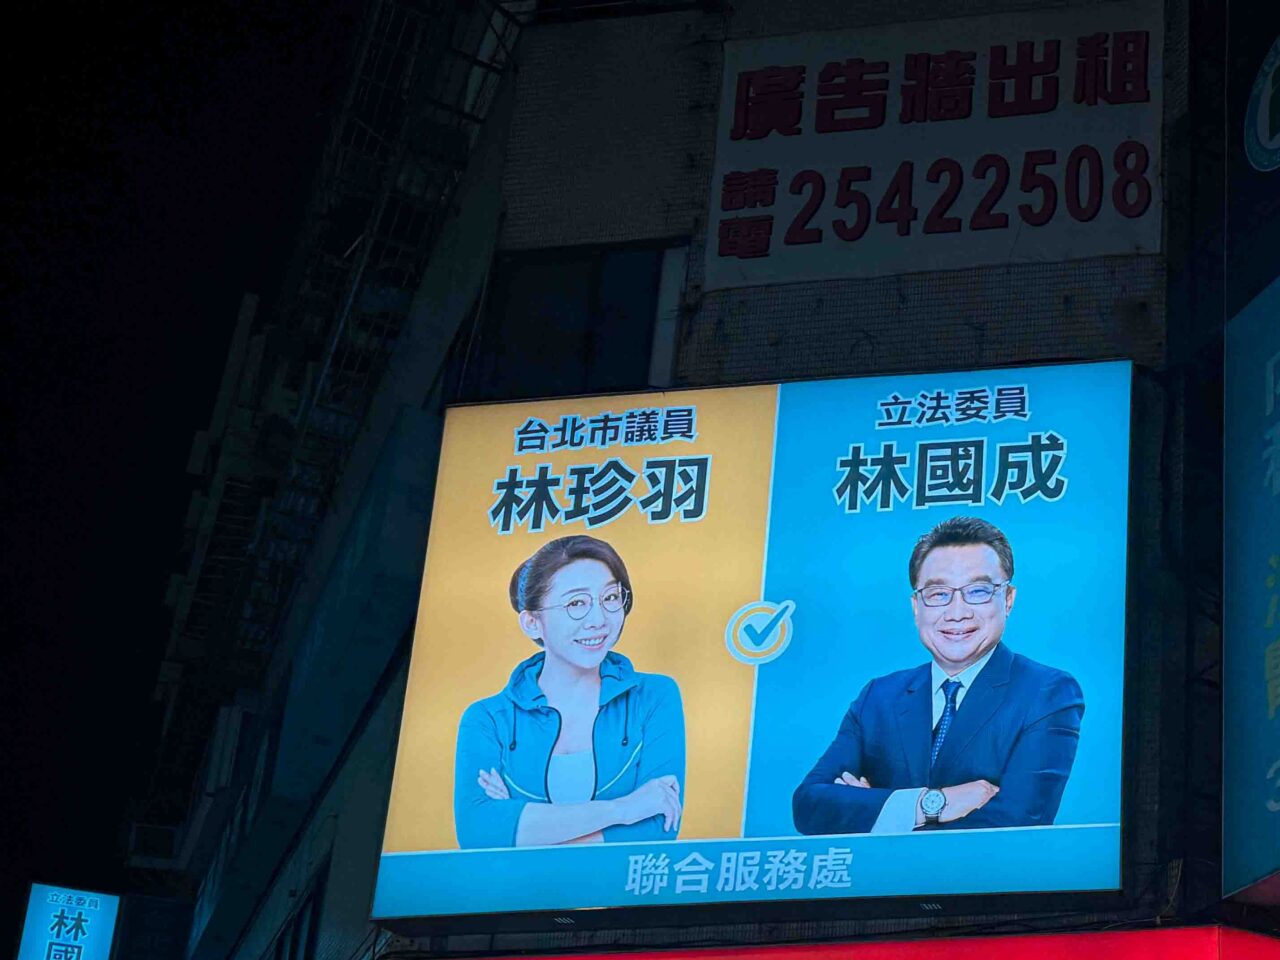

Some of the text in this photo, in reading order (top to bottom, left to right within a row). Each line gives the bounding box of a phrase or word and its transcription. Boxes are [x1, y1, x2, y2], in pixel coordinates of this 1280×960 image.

[728, 30, 1152, 142] 廣告牆出租
[717, 168, 780, 261] 請電
[783, 139, 1153, 247] 25422508
[513, 405, 699, 456] 台北市議員
[875, 384, 1032, 431] 立法委員
[487, 453, 713, 536] 林珍羽
[833, 432, 1070, 514] 林國成
[624, 845, 853, 897] 聯合服務處
